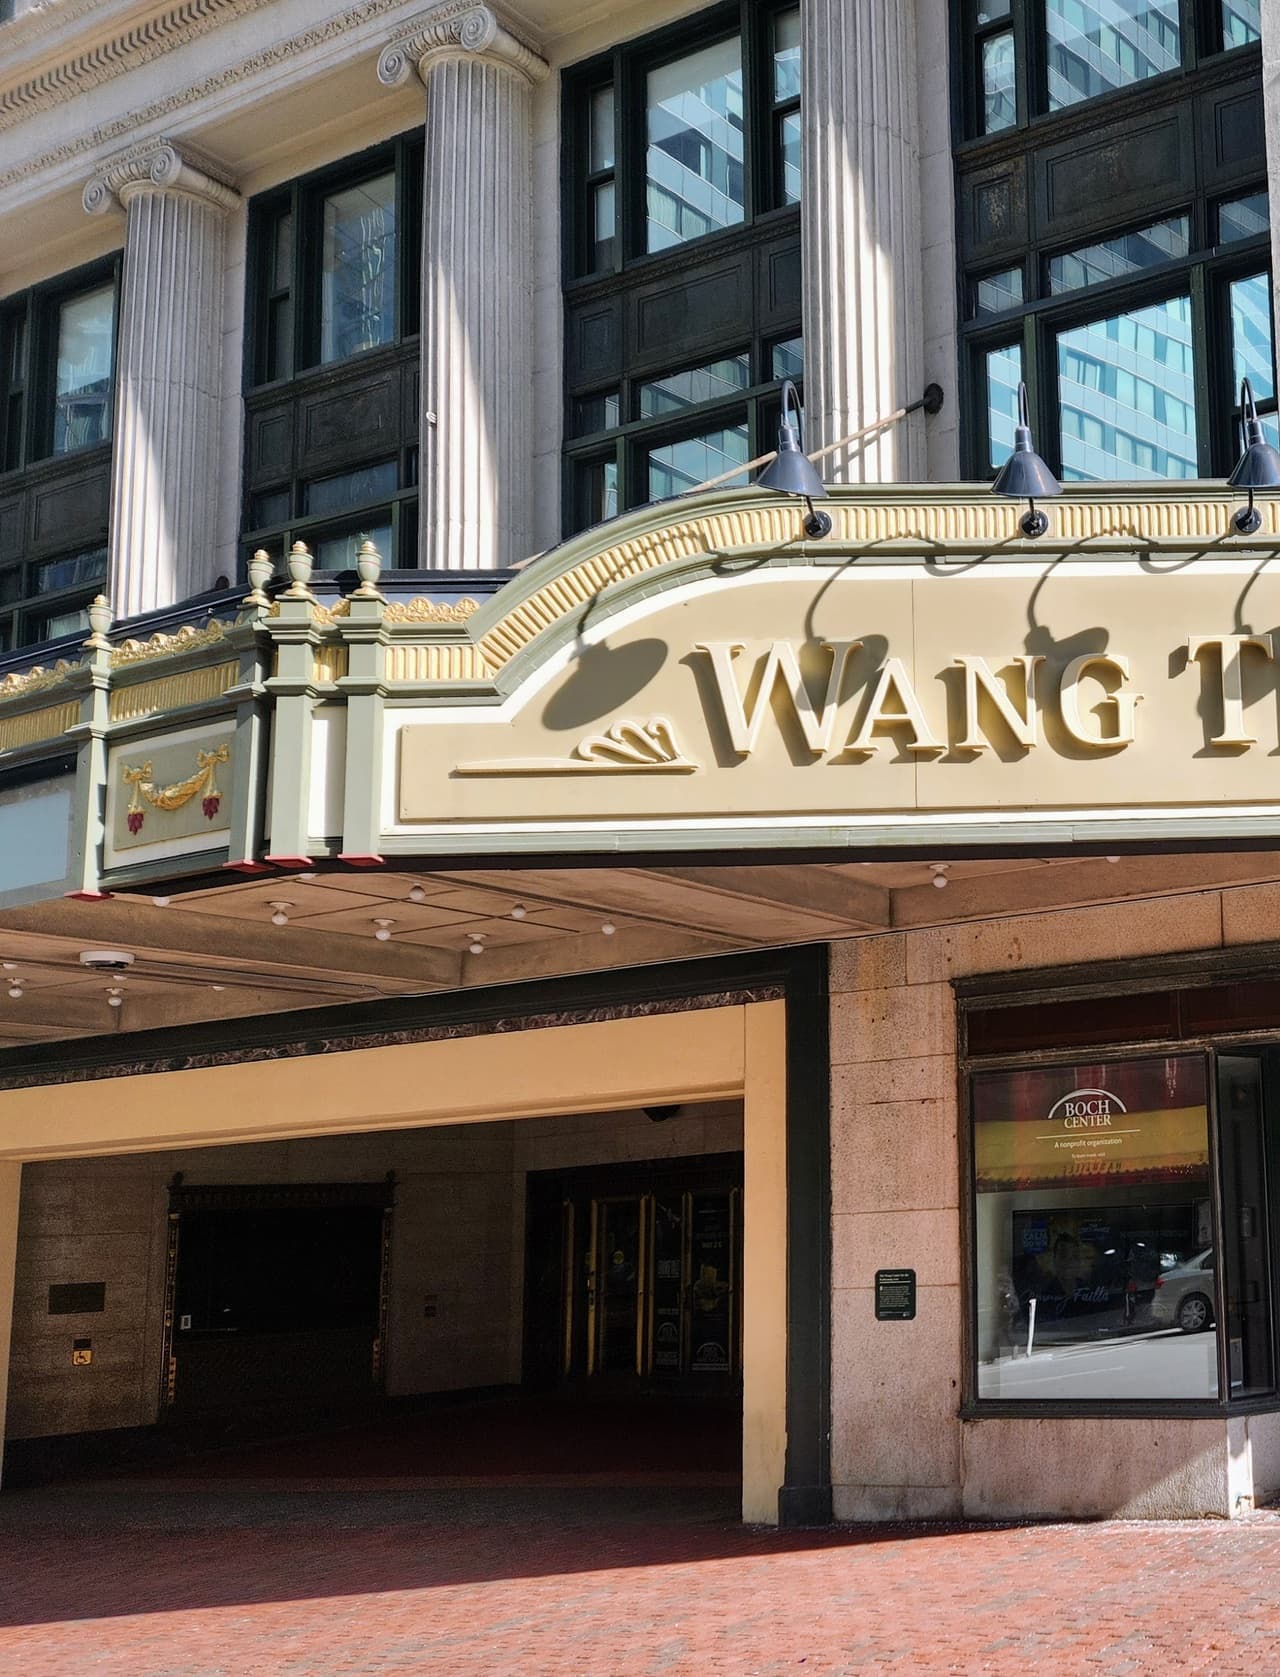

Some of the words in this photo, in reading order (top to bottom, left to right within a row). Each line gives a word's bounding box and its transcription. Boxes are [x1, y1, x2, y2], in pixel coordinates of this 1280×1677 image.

[695, 640, 1145, 756] WANG
[1065, 1099, 1111, 1117] BOCH
[1064, 1114, 1112, 1129] CENTER
[1054, 1141, 1060, 1149] A
[1060, 1140, 1086, 1149] nonprofit
[1087, 1137, 1123, 1147] organization
